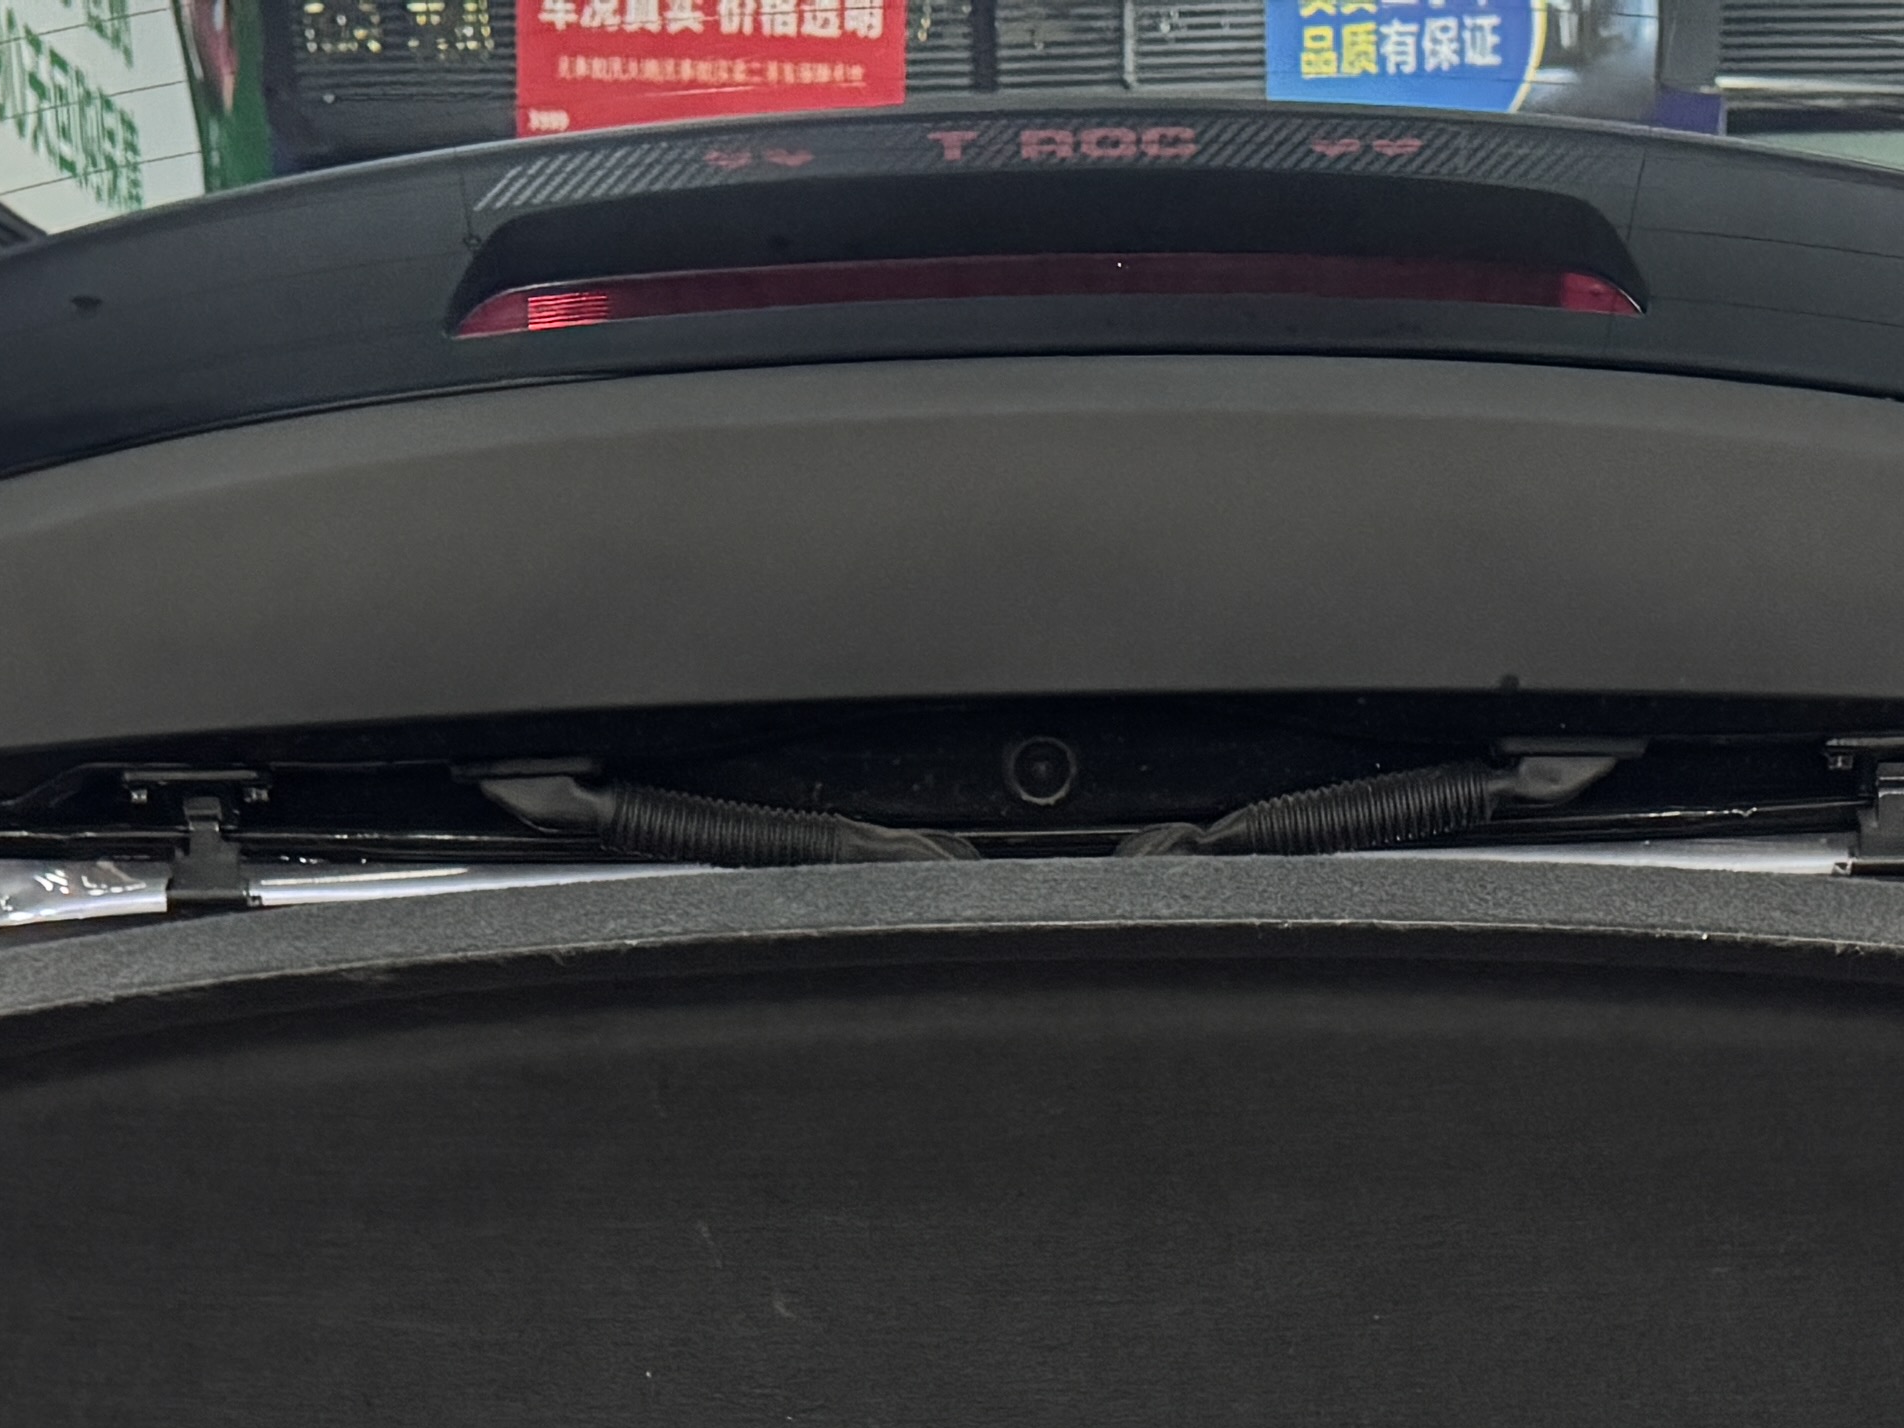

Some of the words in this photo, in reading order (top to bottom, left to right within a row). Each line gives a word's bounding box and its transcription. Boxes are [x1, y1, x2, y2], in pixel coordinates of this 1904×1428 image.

[1300, 15, 1502, 79] 品质有保证
